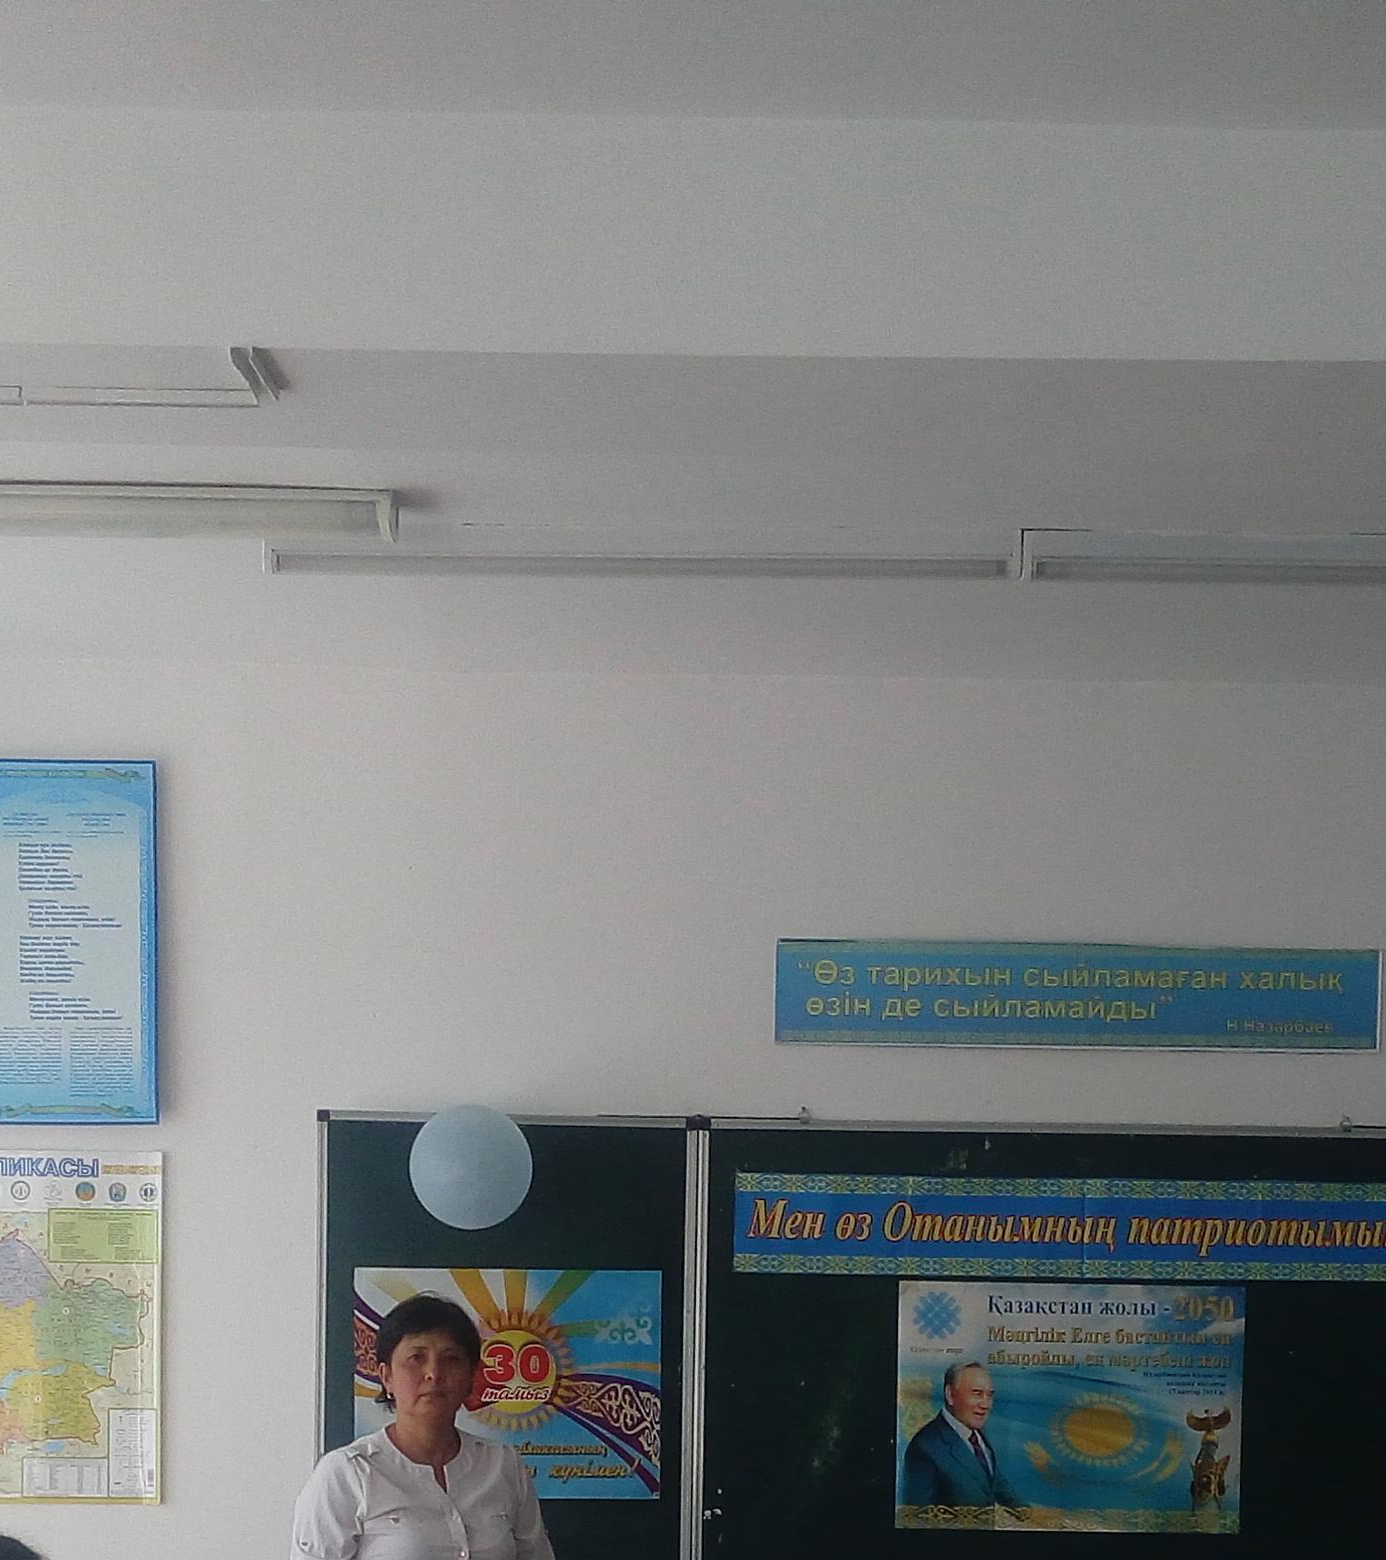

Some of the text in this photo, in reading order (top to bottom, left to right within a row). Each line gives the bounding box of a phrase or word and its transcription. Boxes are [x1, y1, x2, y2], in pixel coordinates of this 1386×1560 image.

[866, 965, 1011, 992] тарихын
[1023, 962, 1227, 990] сыйламаған
[1240, 968, 1344, 993] халық
[805, 991, 871, 1017] өзін
[881, 998, 922, 1021] де
[747, 1197, 826, 1242] Мен
[835, 1210, 874, 1242] өз
[882, 1199, 1117, 1253] Отанымның
[986, 1294, 1093, 1317] Қазақстан
[1099, 1301, 1157, 1316] жолы
[1172, 1295, 1236, 1323] 2050
[482, 1343, 551, 1385] 30
[480, 1385, 551, 1403] тамыз
